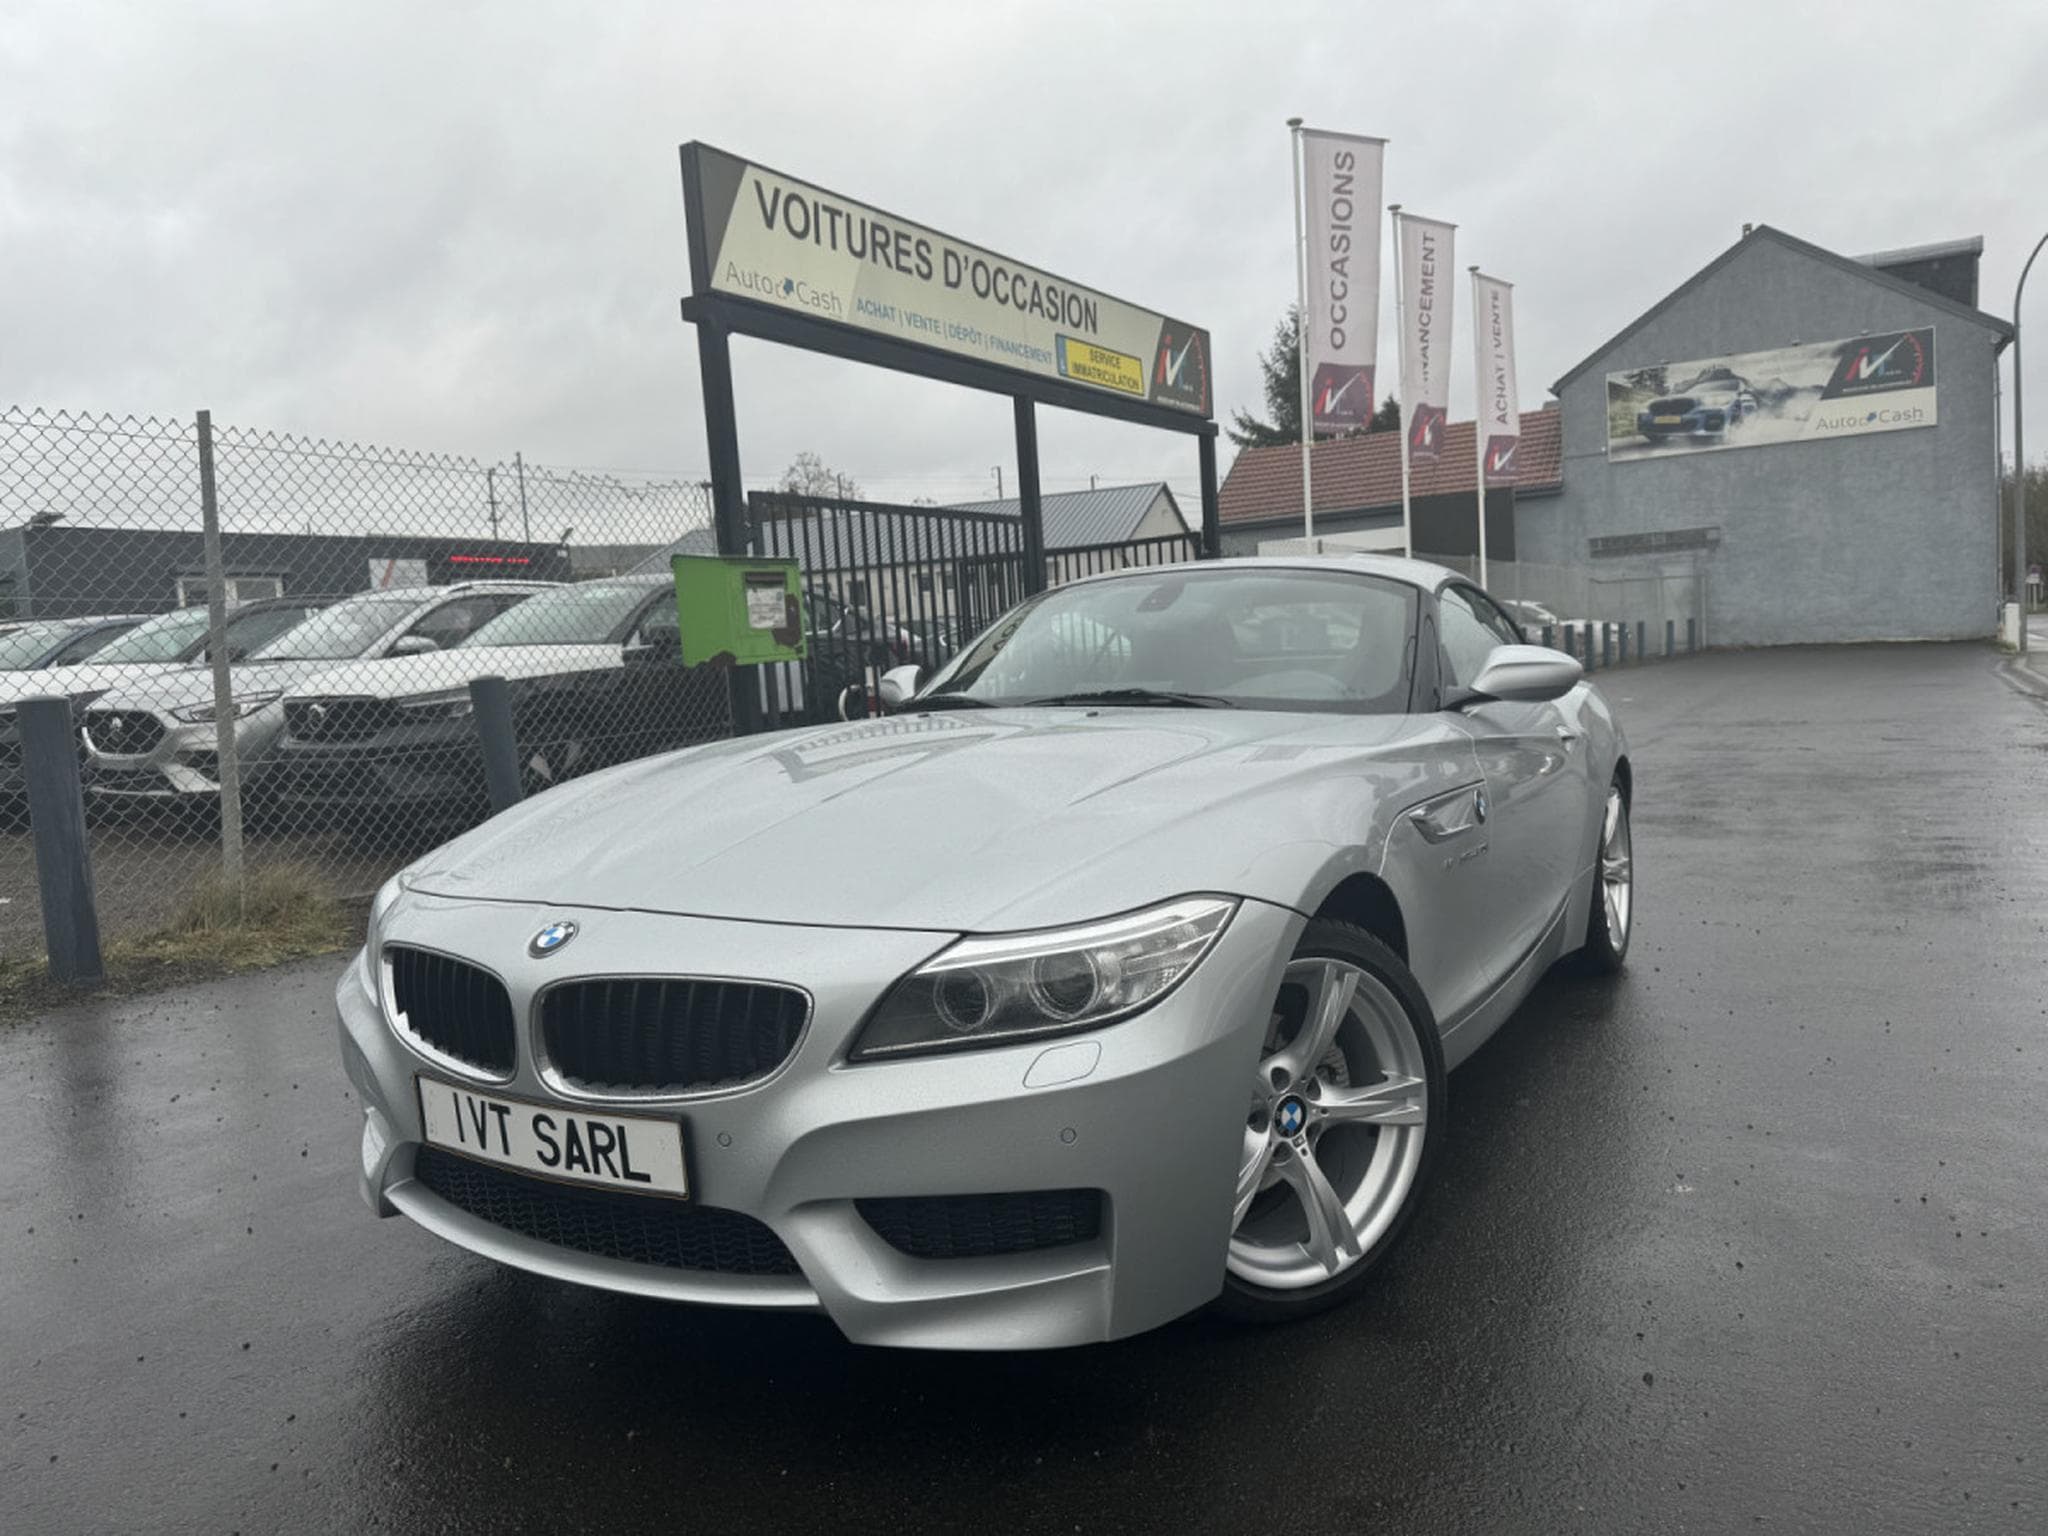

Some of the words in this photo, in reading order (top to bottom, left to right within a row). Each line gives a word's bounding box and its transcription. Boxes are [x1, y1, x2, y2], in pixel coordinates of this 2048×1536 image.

[754, 179, 933, 281] VOITURES
[943, 248, 1097, 335] D'OCCASION
[1330, 150, 1355, 350] OCCASIONS
[857, 299, 896, 322] ACHAT
[904, 311, 941, 335] VENTE
[949, 322, 983, 346] DÉPÔT
[989, 335, 1053, 364] FINANCEMENT
[1491, 290, 1503, 348] VENTE
[1071, 361, 1140, 391] IMMATRICULATION
[1089, 348, 1121, 369] SERVICE
[1496, 365, 1508, 424] ACHAT
[453, 1092, 511, 1156] IVT
[532, 1113, 651, 1183] SARL
